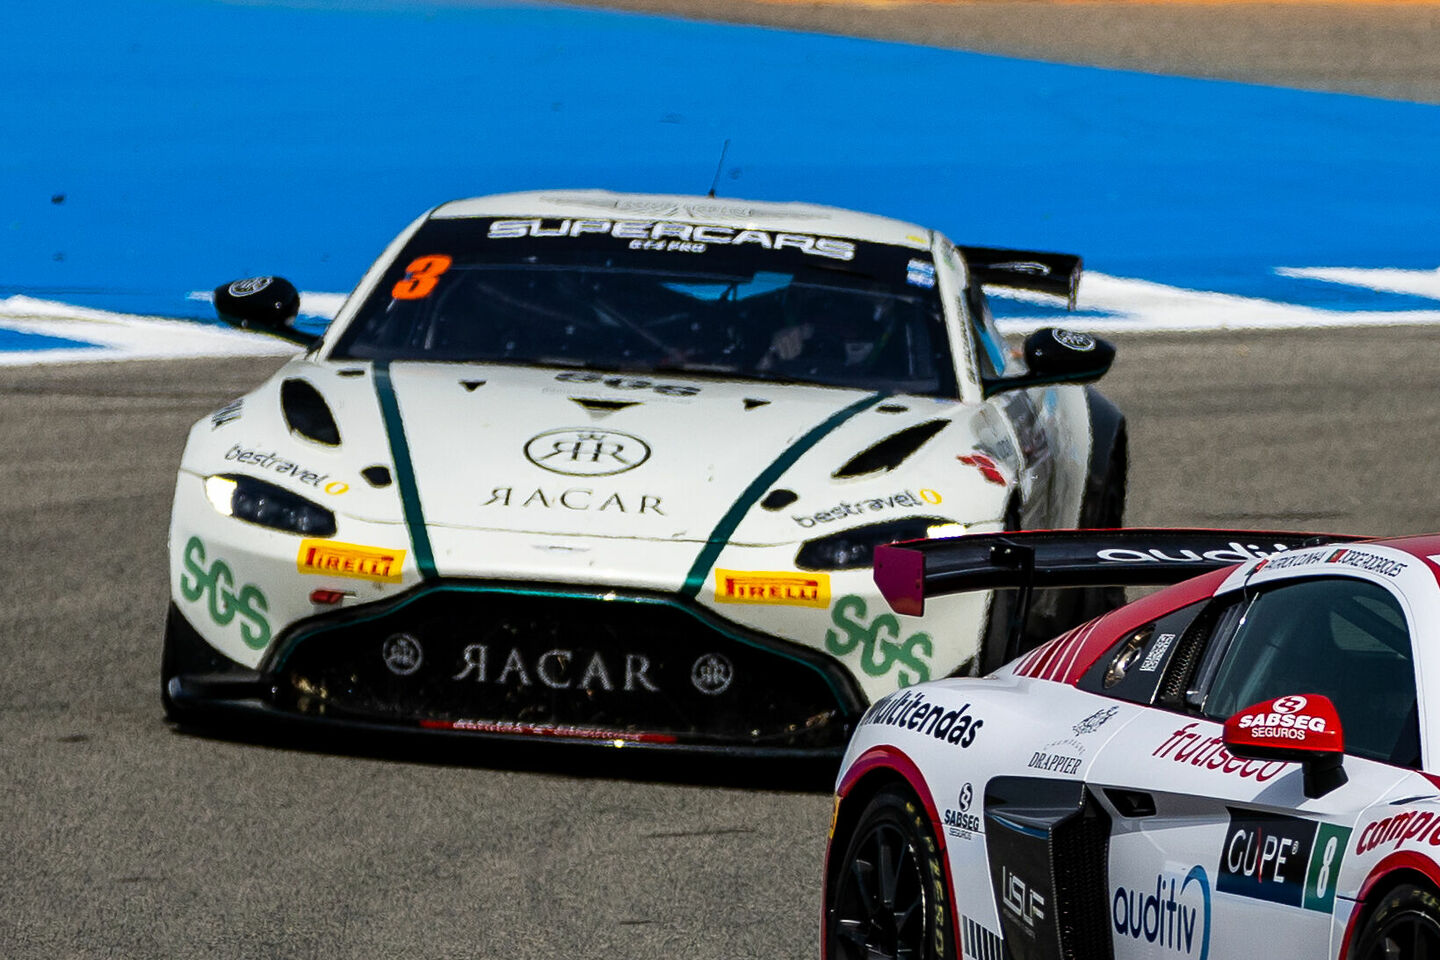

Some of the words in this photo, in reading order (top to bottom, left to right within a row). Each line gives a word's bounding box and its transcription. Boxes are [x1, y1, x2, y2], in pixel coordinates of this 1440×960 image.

[487, 219, 855, 260] SUPERCARS
[392, 253, 453, 300] 3
[304, 547, 394, 577] PIRELLI
[180, 536, 271, 650] SGS
[725, 577, 818, 600] PIRELLI
[825, 594, 933, 688] SGS
[1238, 713, 1326, 733] SABSEG
[1251, 727, 1306, 740] SEGUROS
[1027, 751, 1082, 775] DRAPPIER
[944, 809, 980, 831] SABSEG
[1316, 836, 1338, 898] 8
[1113, 874, 1196, 954] auditiv
